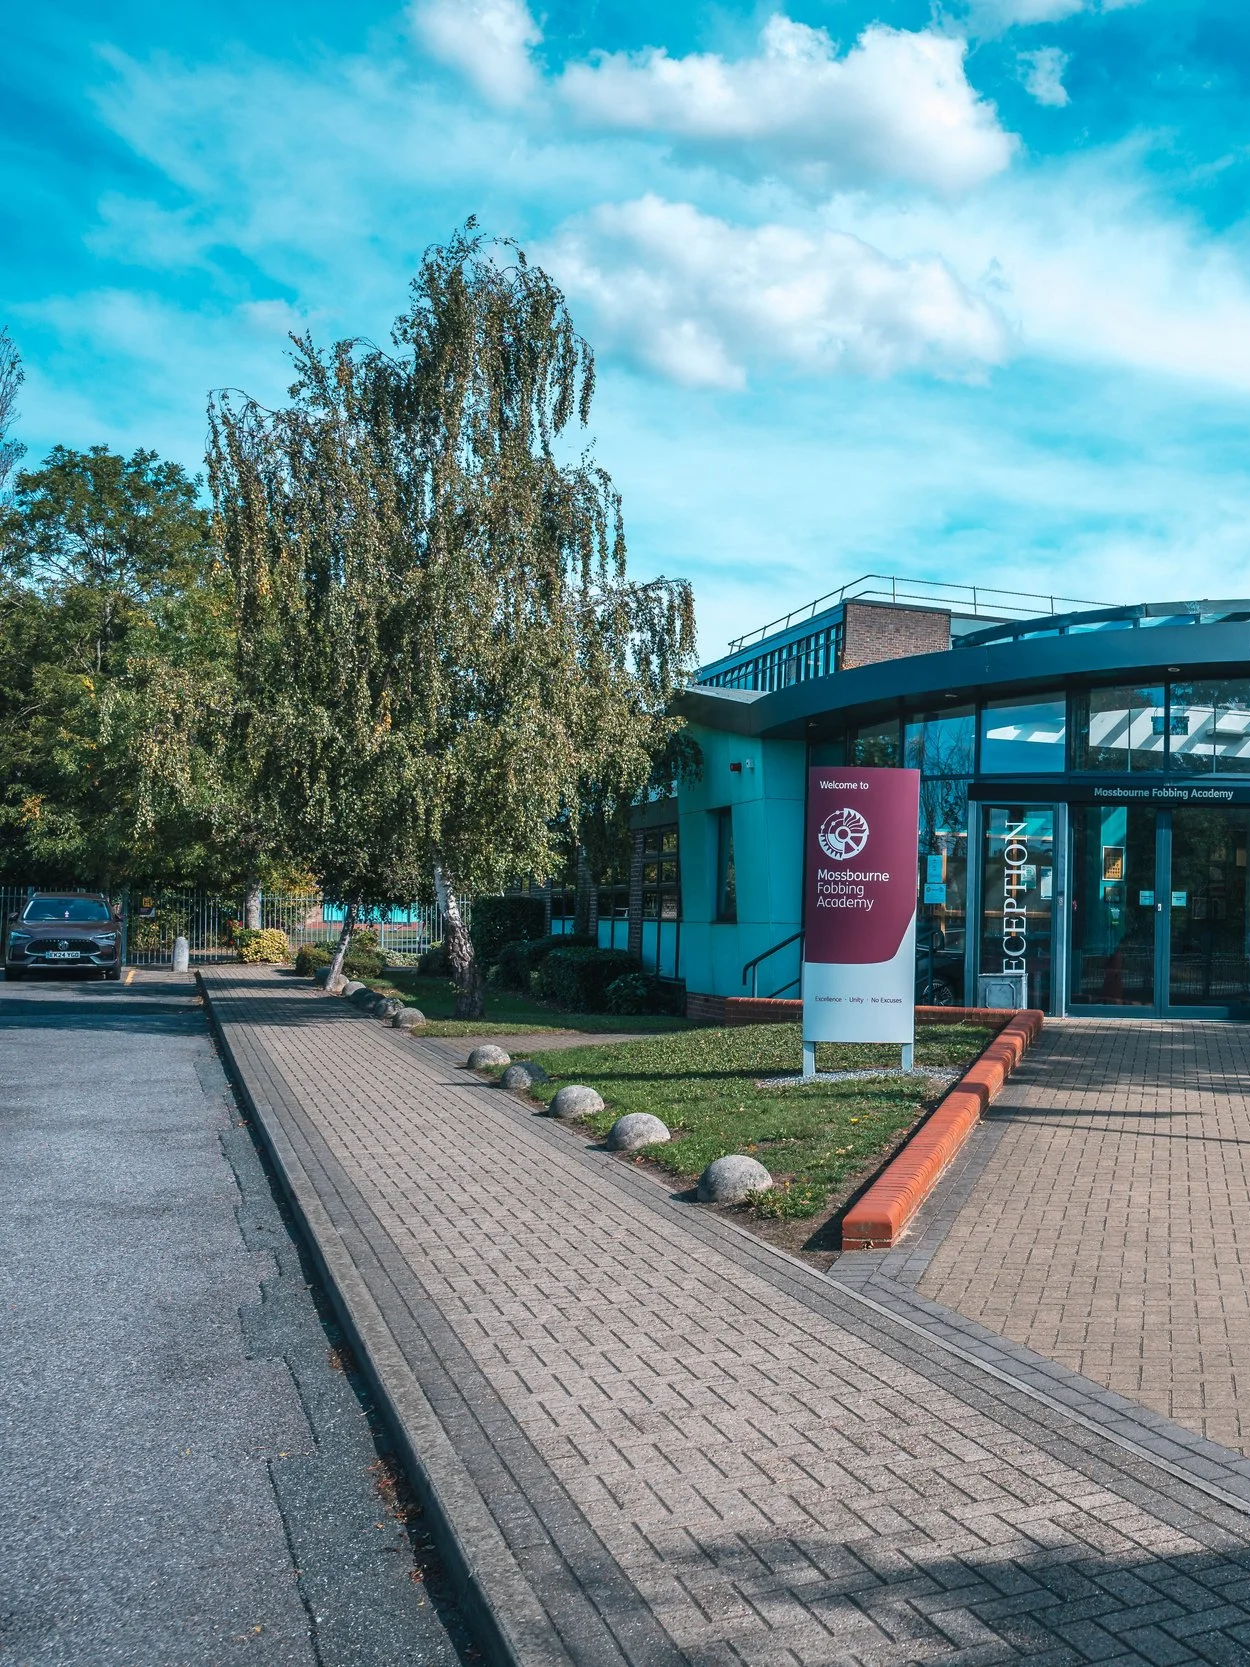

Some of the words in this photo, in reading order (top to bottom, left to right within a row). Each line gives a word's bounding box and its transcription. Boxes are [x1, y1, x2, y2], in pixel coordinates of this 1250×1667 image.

[820, 780, 858, 790] Welcome
[860, 781, 869, 790] to
[1094, 787, 1150, 797] Mossbourne
[1152, 788, 1189, 799] Fobbing
[1191, 788, 1234, 800] Academy
[817, 868, 890, 881] Mossbourne
[817, 882, 865, 897] Fobbing
[816, 895, 874, 911] Academy
[1003, 820, 1028, 974] ECEPTION
[815, 995, 842, 1003] Excellence
